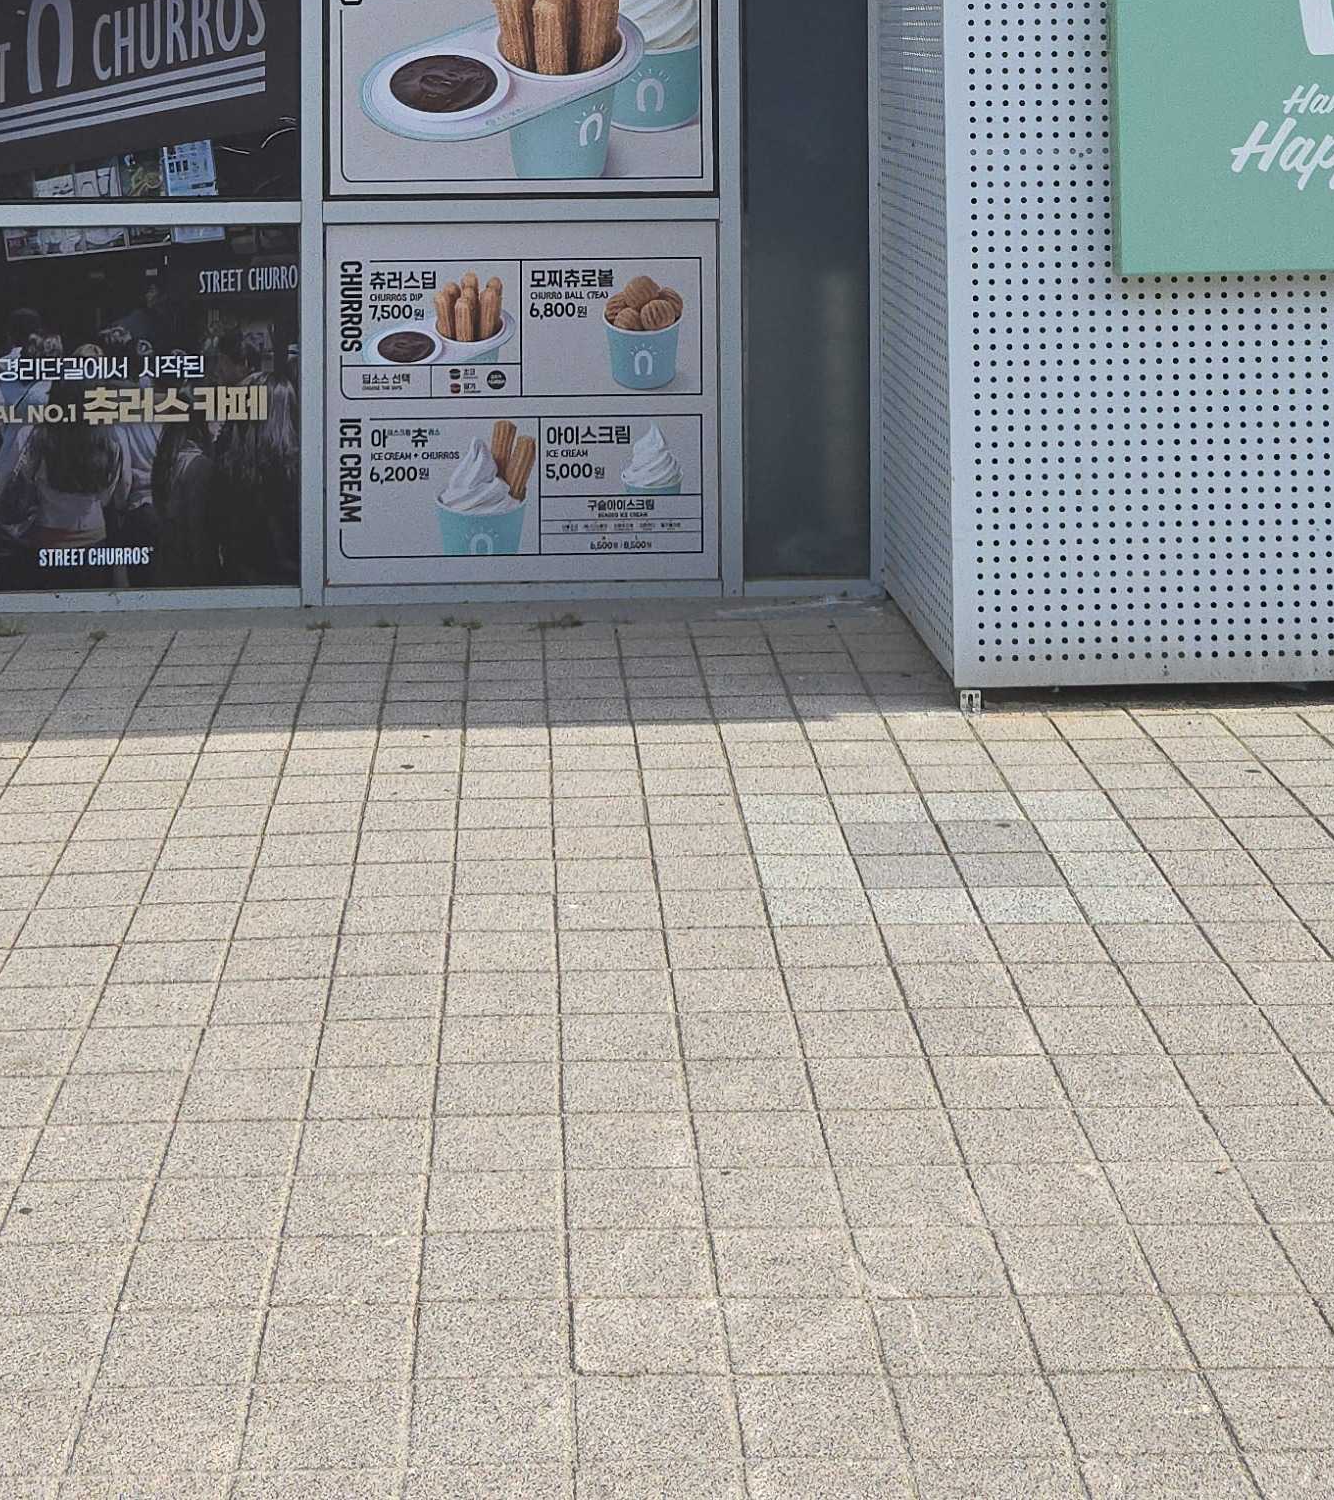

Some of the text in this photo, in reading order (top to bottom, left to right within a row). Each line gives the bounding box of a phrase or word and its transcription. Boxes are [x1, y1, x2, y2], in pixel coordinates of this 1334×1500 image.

[199, 264, 299, 293] STREET CHURRO
[369, 271, 437, 290] 츄러스딥
[530, 268, 614, 288] 모찌츄로볼
[340, 260, 363, 353] CHURROS
[369, 293, 424, 302] CHURROS DIP
[368, 304, 425, 322] 7,500원
[529, 302, 588, 320] 6,800원
[138, 355, 205, 379] 시작된
[27, 402, 77, 424] NO.1
[546, 424, 631, 446] 아이스크림
[421, 451, 460, 460] CHURROS
[546, 449, 589, 458] ICE CREAM
[339, 418, 362, 523] ICE CREAM
[369, 465, 430, 484] 6,200원
[545, 462, 605, 482] 5,000원
[38, 546, 150, 567] STREET CHURROS
